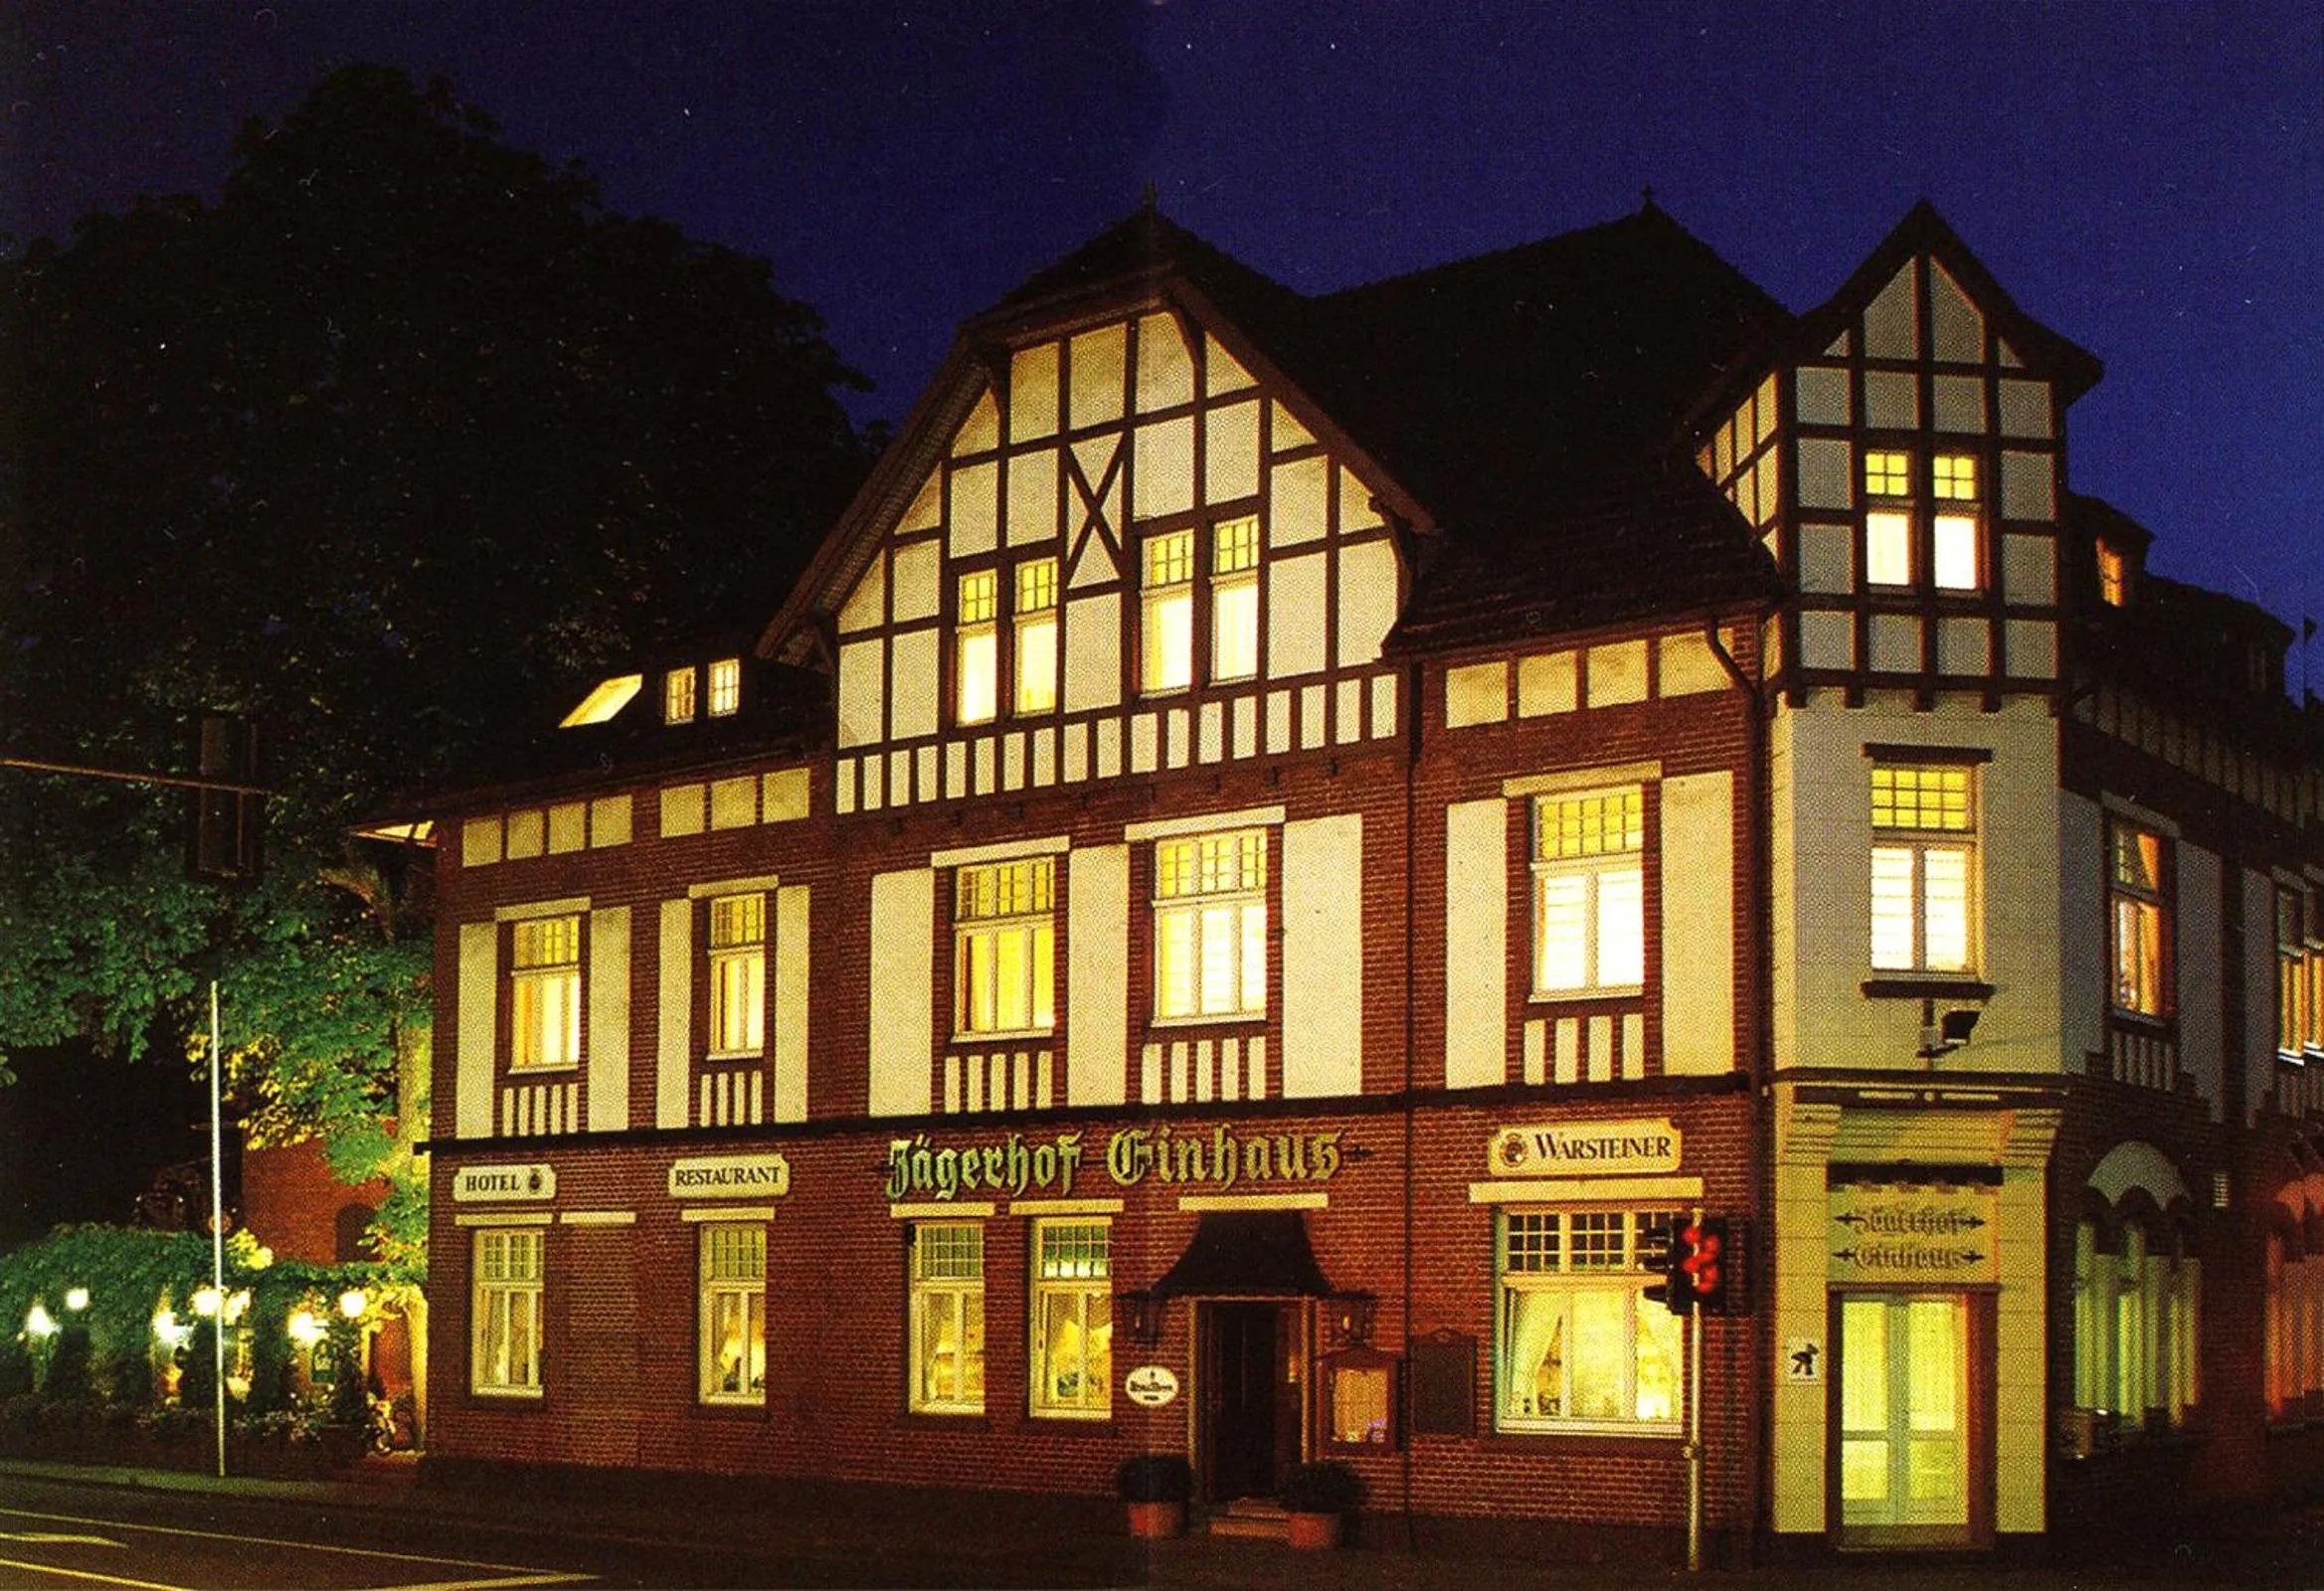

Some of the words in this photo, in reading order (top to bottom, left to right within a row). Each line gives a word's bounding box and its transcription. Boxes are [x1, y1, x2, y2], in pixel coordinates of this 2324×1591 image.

[1534, 1133, 1672, 1160] WARSTEINER
[885, 1131, 1084, 1201] Jägerhof
[1107, 1123, 1346, 1192] Einhaus
[465, 1174, 521, 1191] HOTEL
[675, 1166, 781, 1186] RESTAURANT
